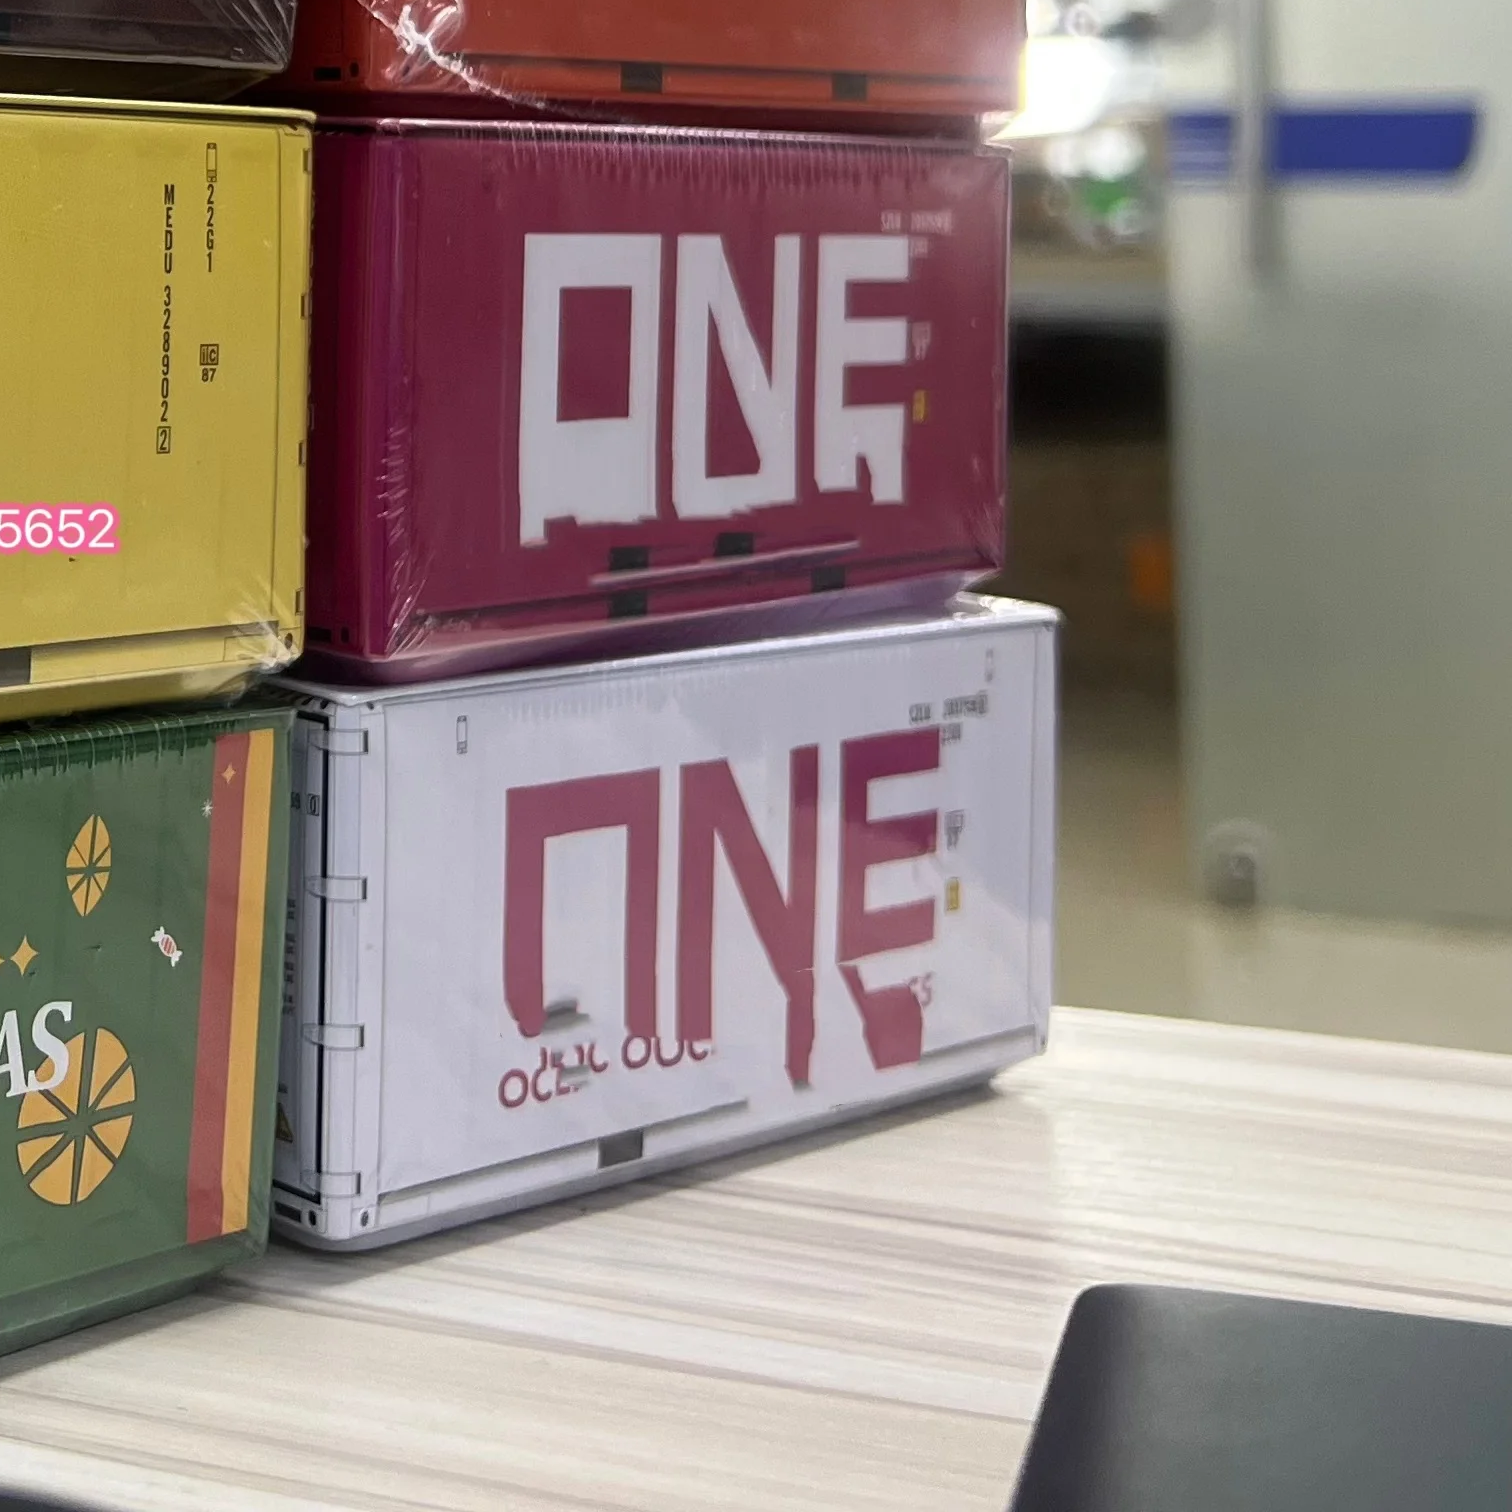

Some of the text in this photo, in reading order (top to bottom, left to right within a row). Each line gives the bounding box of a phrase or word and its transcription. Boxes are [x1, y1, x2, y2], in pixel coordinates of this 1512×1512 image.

[163, 184, 175, 274] MEDU
[205, 183, 215, 273] 22G1
[159, 285, 172, 423] 328902
[201, 368, 216, 383] 87
